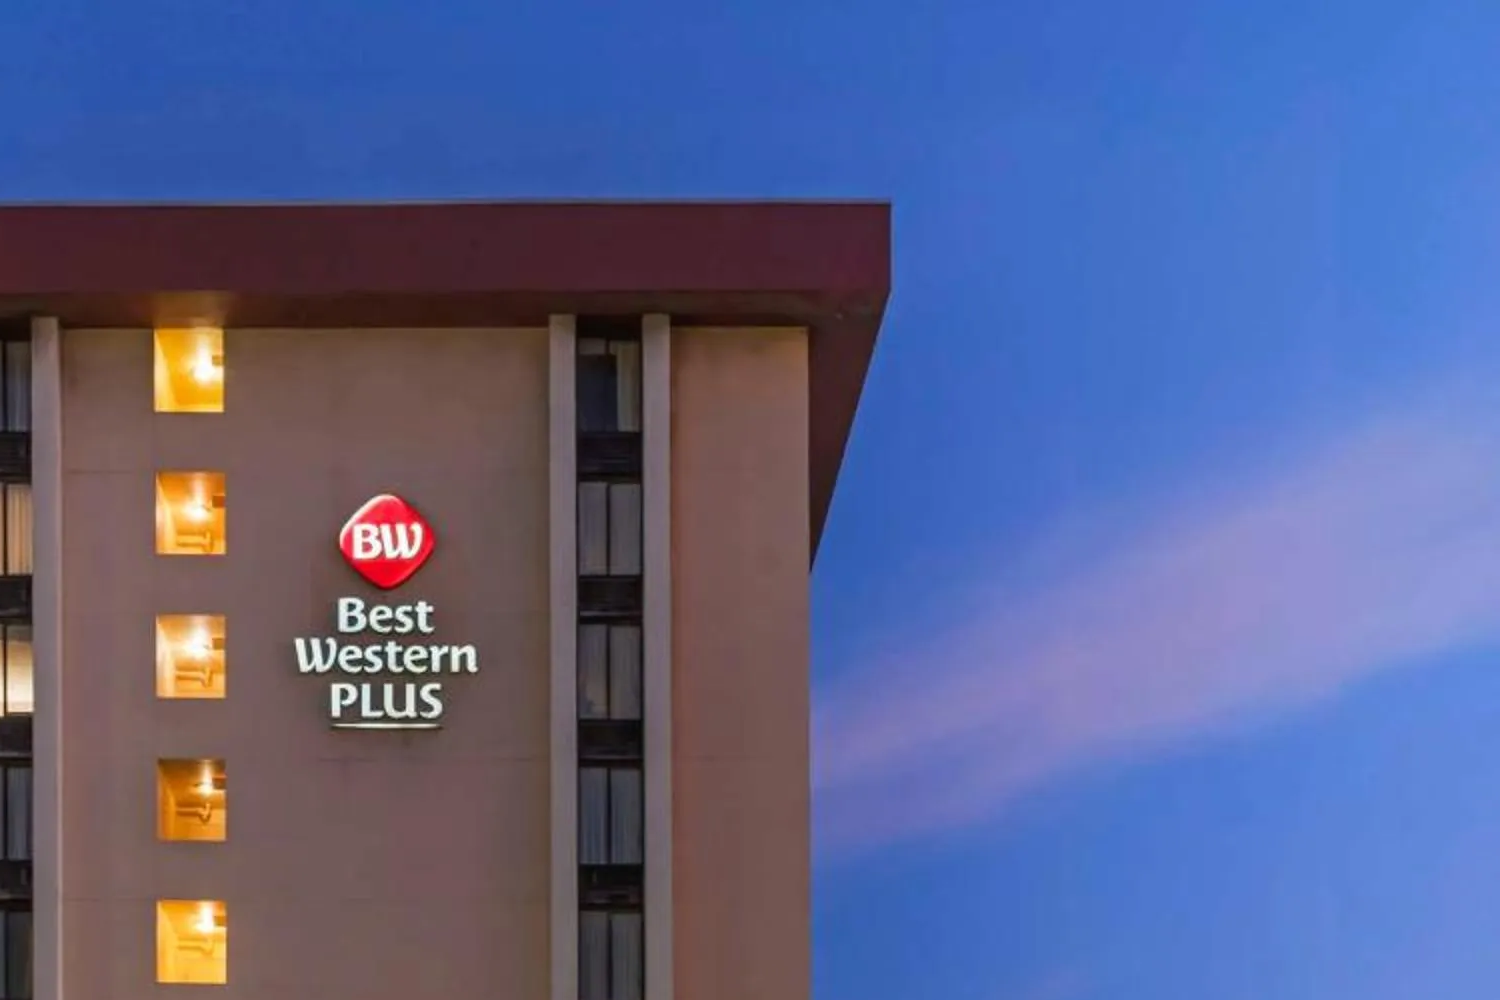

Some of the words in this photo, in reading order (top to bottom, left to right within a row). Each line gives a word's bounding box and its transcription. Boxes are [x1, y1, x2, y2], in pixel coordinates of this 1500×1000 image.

[352, 522, 424, 560] BW
[337, 597, 435, 634] Best
[294, 636, 479, 674] Western
[330, 682, 444, 719] PLUS
